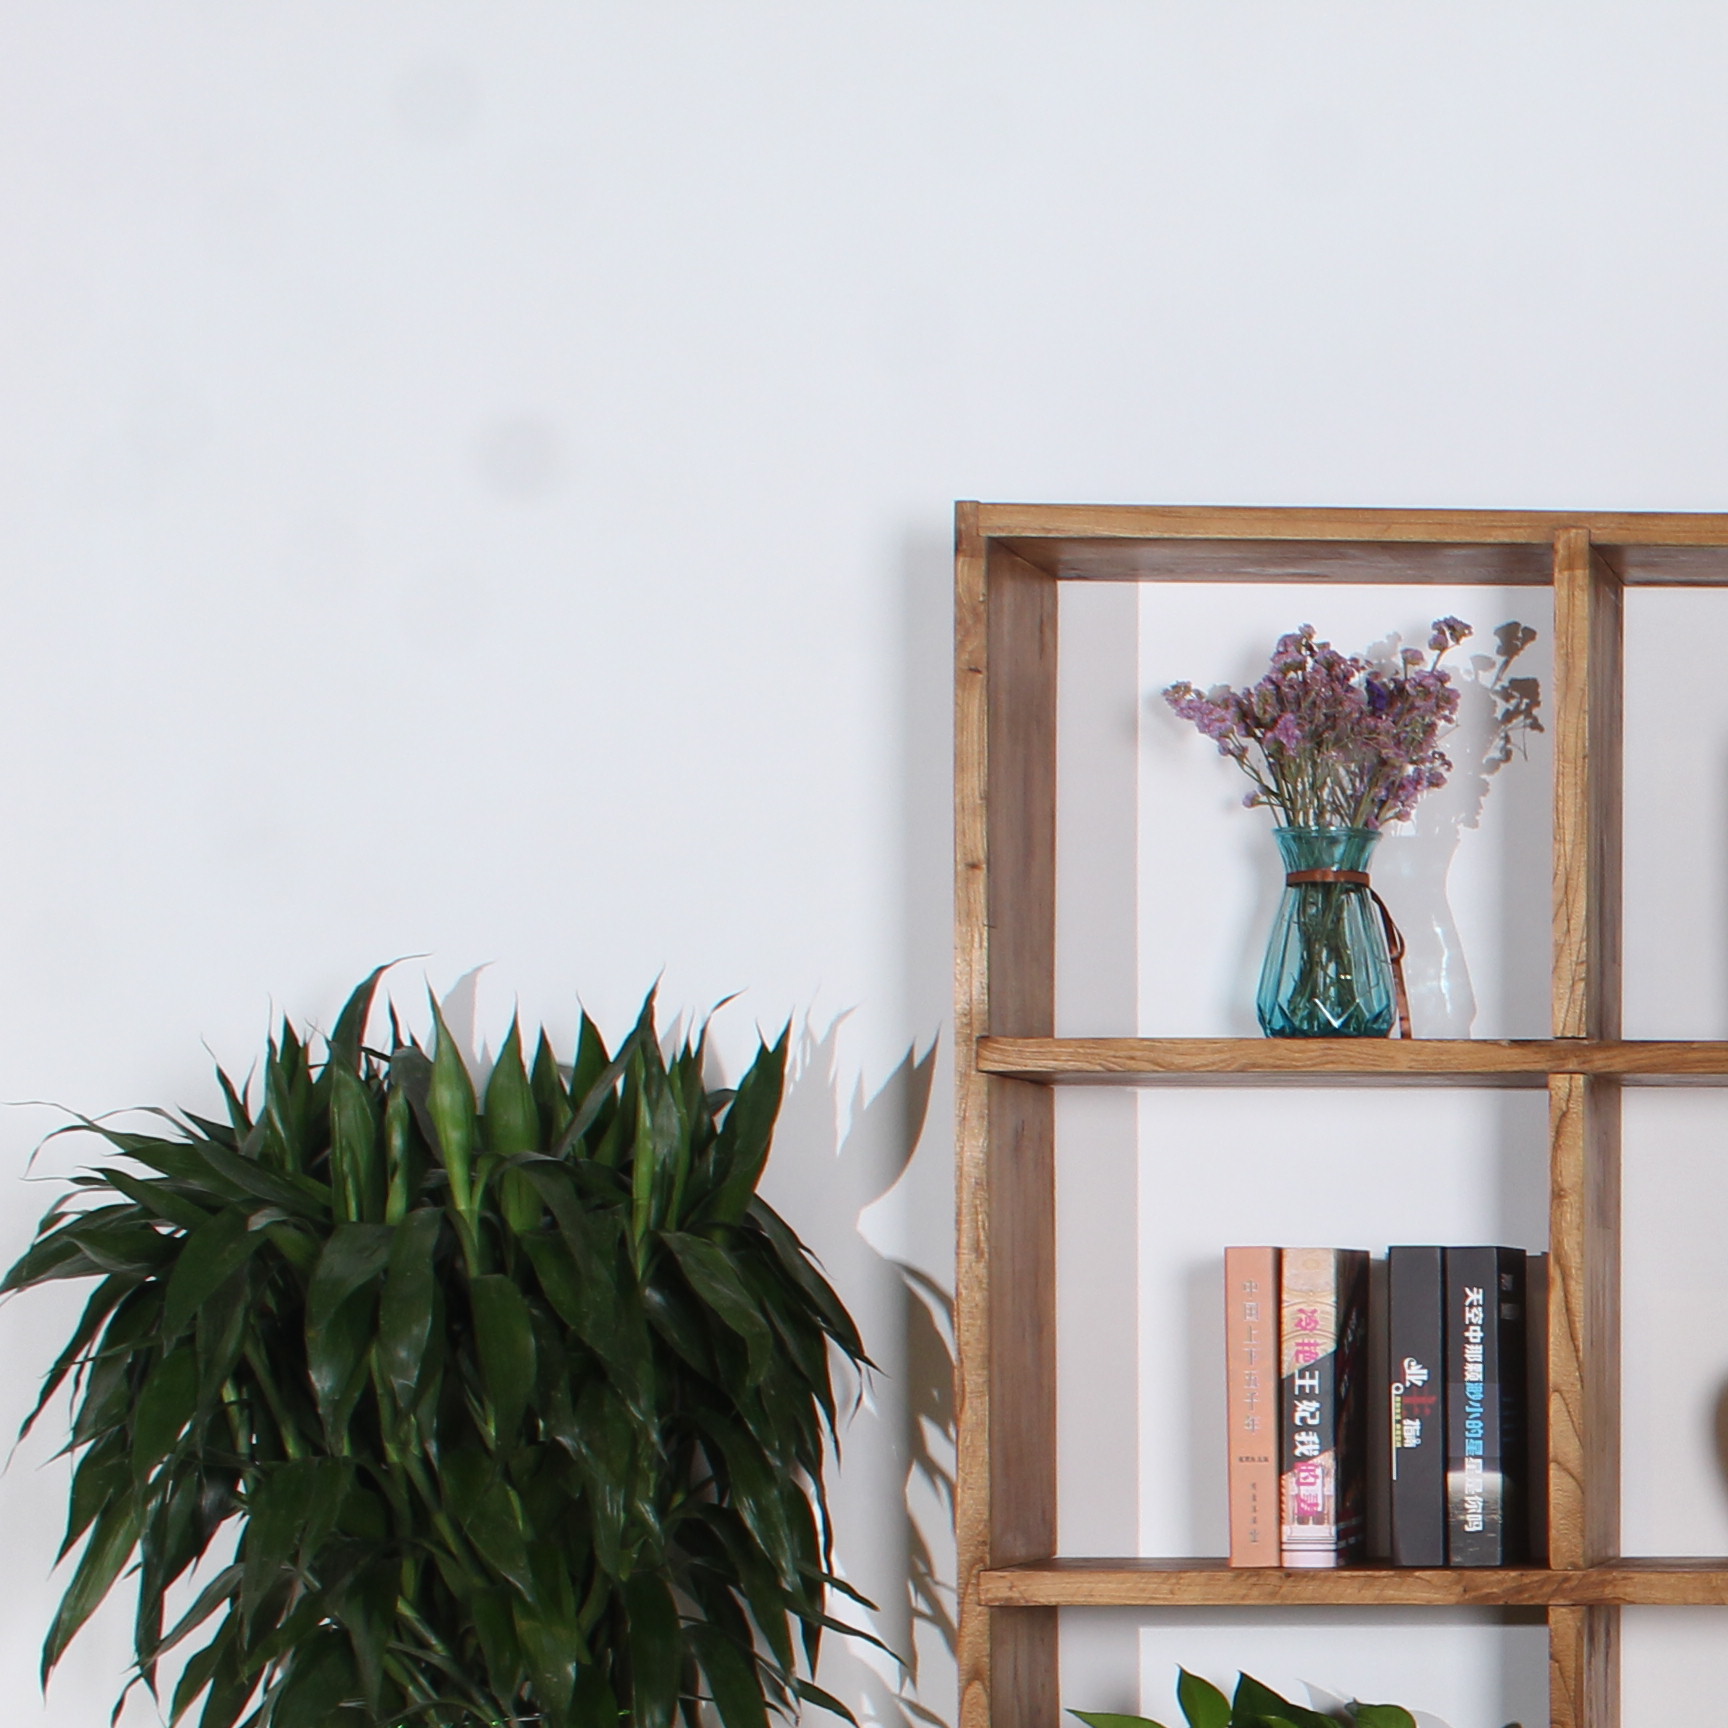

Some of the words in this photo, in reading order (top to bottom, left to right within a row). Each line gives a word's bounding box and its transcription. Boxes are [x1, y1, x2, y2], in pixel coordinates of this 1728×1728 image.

[1463, 1286, 1485, 1532] 天空中那颗渺小的星星是你吗
